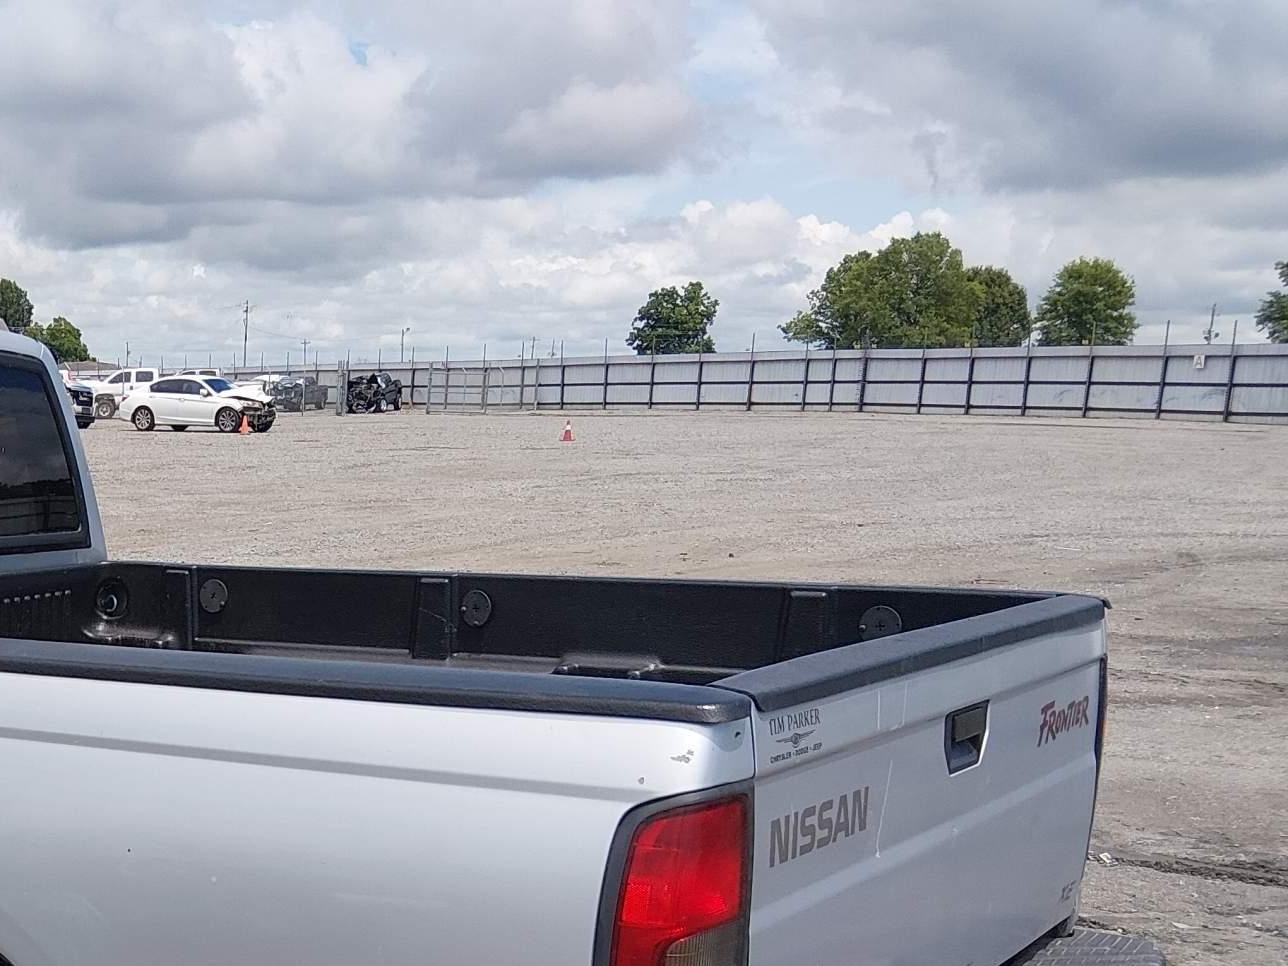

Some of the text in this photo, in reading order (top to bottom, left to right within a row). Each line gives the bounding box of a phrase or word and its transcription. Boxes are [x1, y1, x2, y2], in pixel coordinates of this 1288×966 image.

[769, 708, 821, 735] TIM PARKER
[1037, 695, 1089, 748] FRONTIER
[769, 786, 870, 868] NISSAN
